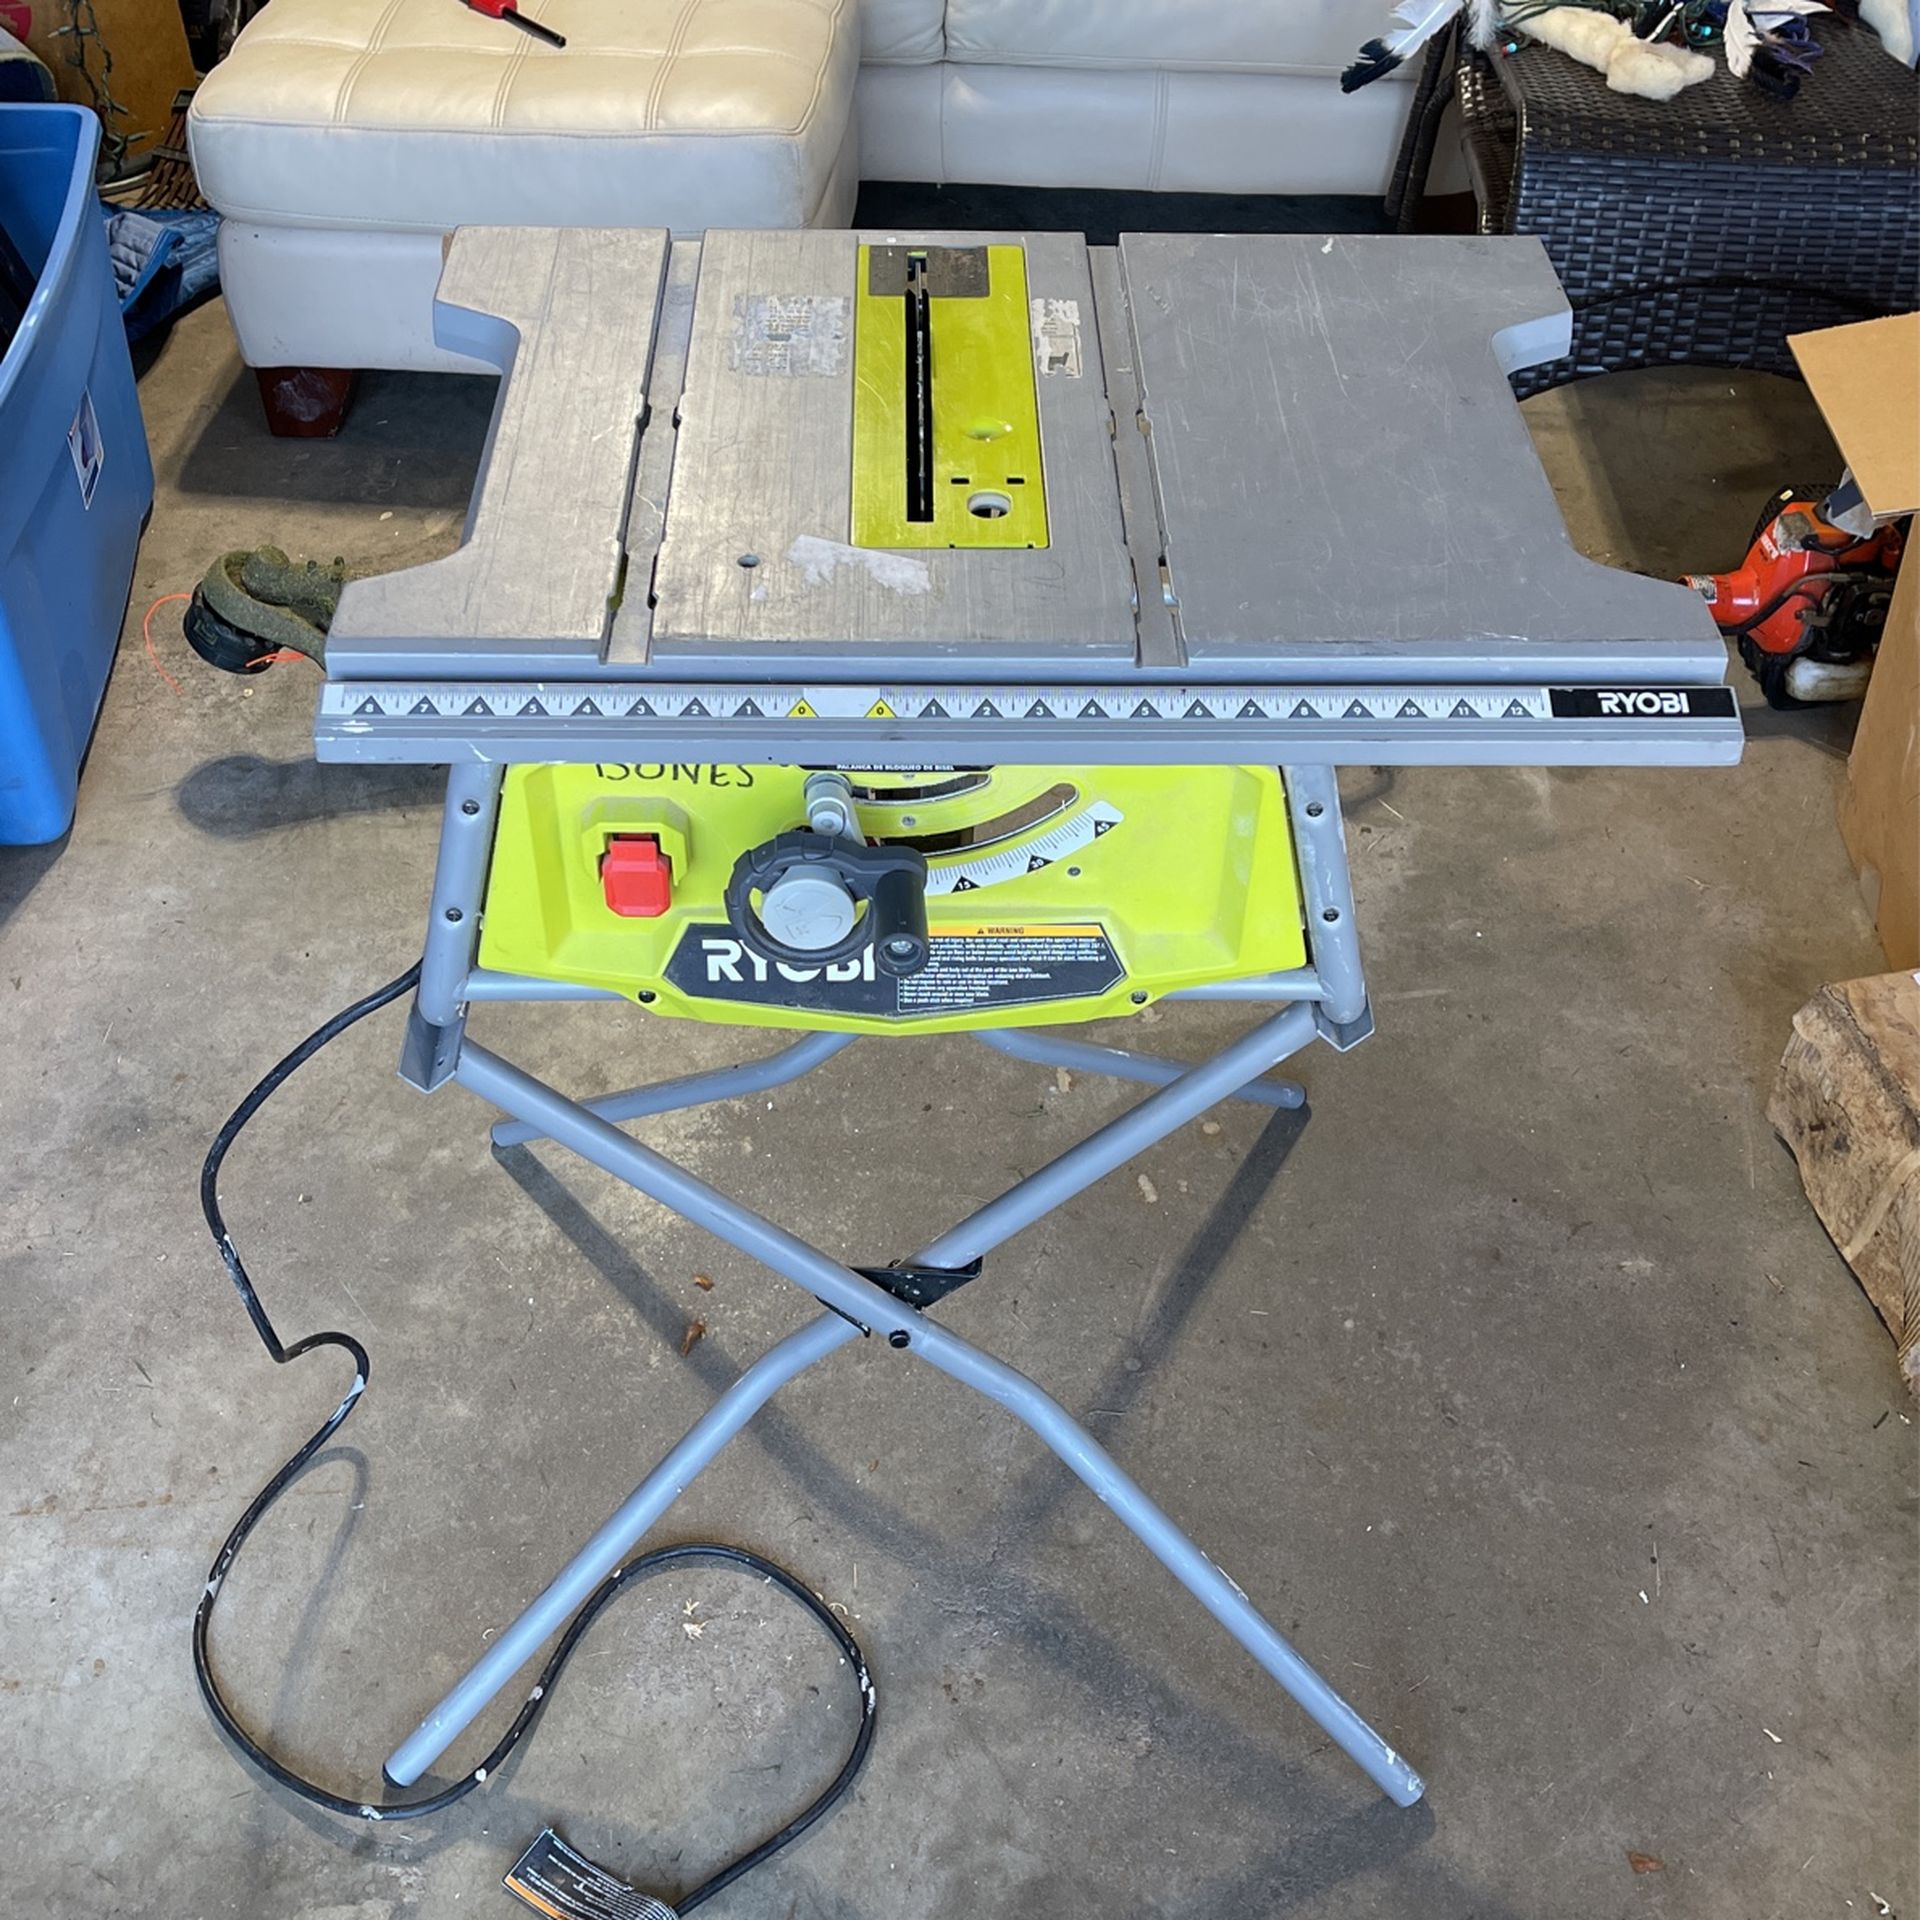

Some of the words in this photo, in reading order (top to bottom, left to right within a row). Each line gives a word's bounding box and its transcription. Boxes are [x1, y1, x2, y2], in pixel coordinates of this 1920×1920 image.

[1597, 692, 1690, 714] RYOBI
[365, 703, 374, 713] 8
[420, 704, 428, 713] 7
[475, 704, 483, 713] 6
[529, 704, 537, 714] 5
[582, 704, 591, 714] 4
[637, 704, 645, 714] 3
[691, 705, 699, 715] 2
[745, 705, 751, 715] 1
[798, 706, 805, 715] 0
[876, 706, 884, 715] 0
[930, 706, 936, 715] 1
[983, 707, 991, 716] 2
[1036, 707, 1044, 716] 3
[1088, 707, 1096, 716] 4
[1141, 707, 1149, 716] 5
[1194, 707, 1202, 716] 6
[1247, 707, 1255, 716] 7
[1301, 707, 1309, 716] 8
[1354, 707, 1362, 716] 9
[1405, 707, 1418, 716] 10
[1457, 707, 1469, 716] 11
[1510, 707, 1524, 716] 12
[1031, 858, 1044, 869] 30
[958, 881, 972, 890] 15
[988, 927, 1025, 935] WARNING
